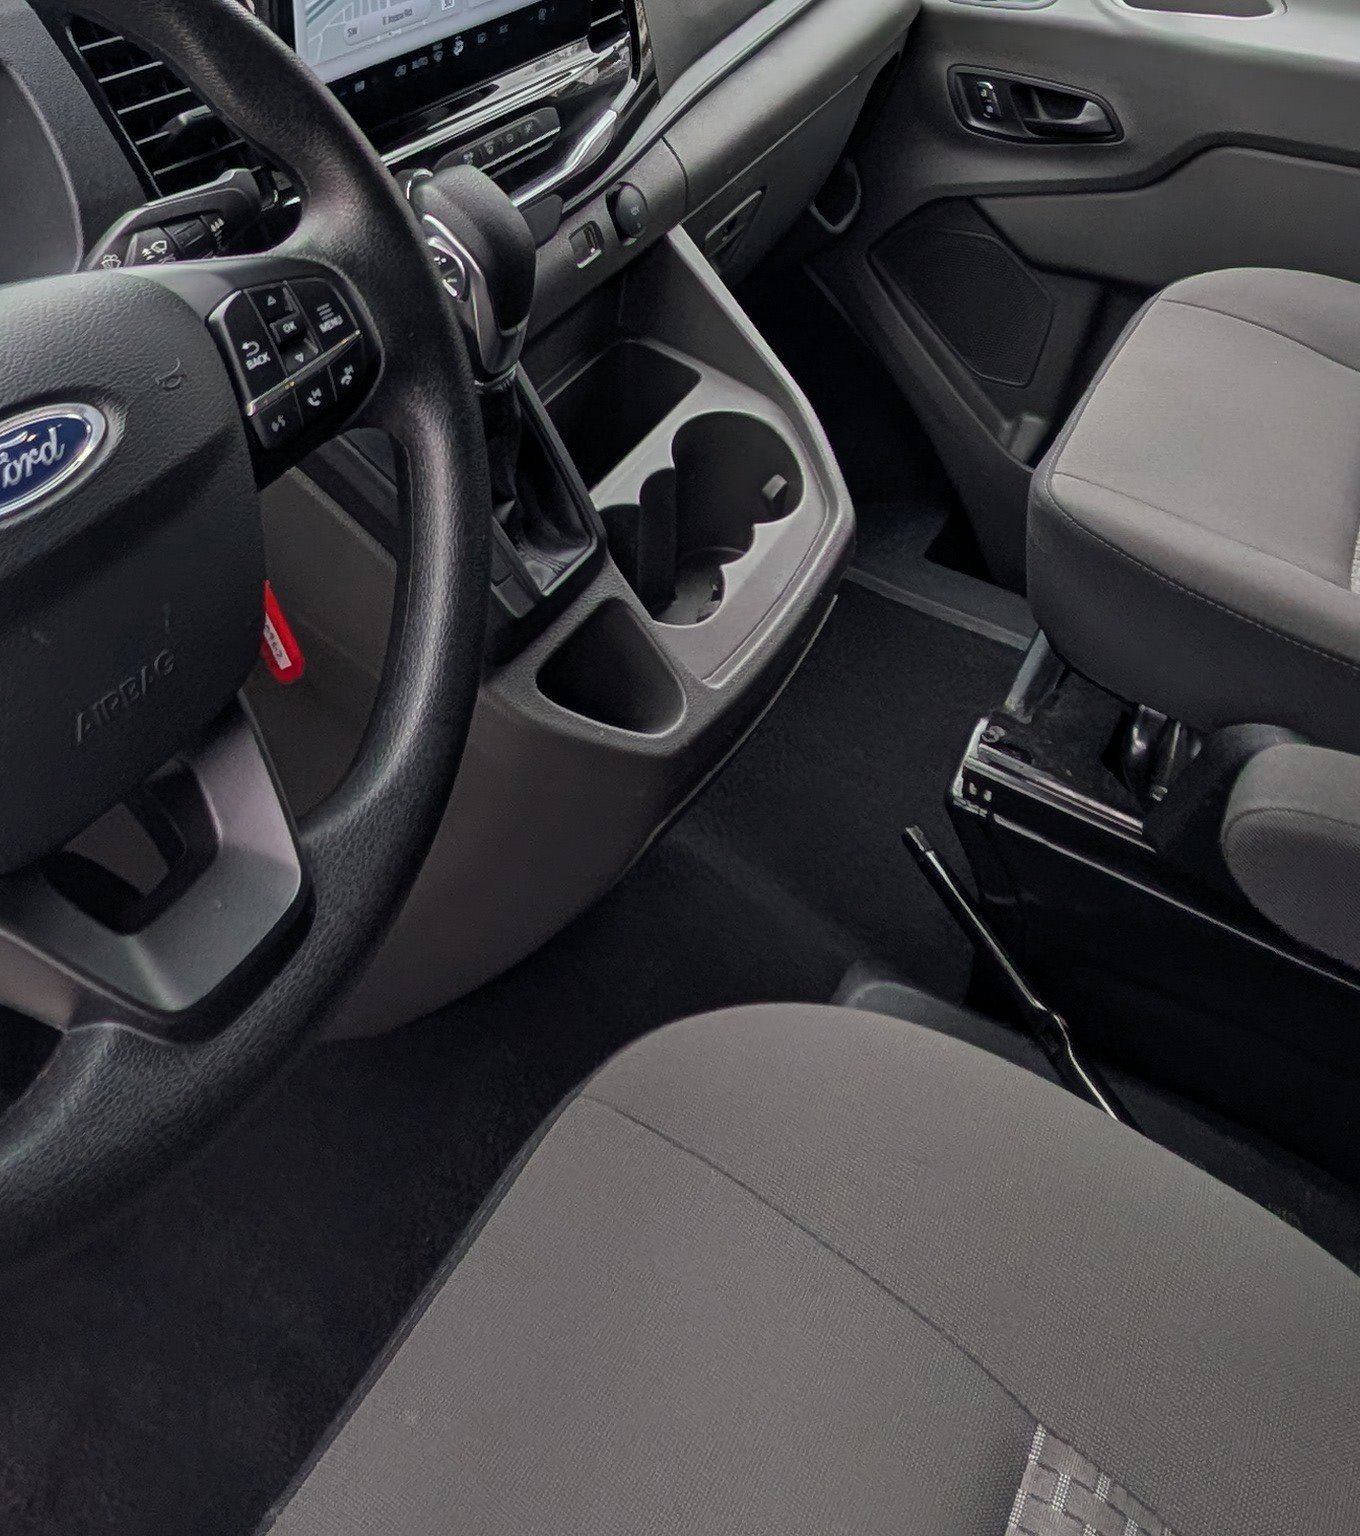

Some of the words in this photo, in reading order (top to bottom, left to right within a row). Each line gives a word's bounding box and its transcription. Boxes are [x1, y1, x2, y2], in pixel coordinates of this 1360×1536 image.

[282, 320, 298, 334] OK
[318, 314, 344, 334] MENU
[244, 350, 272, 371] BACK
[73, 648, 176, 745] AIRBAG
